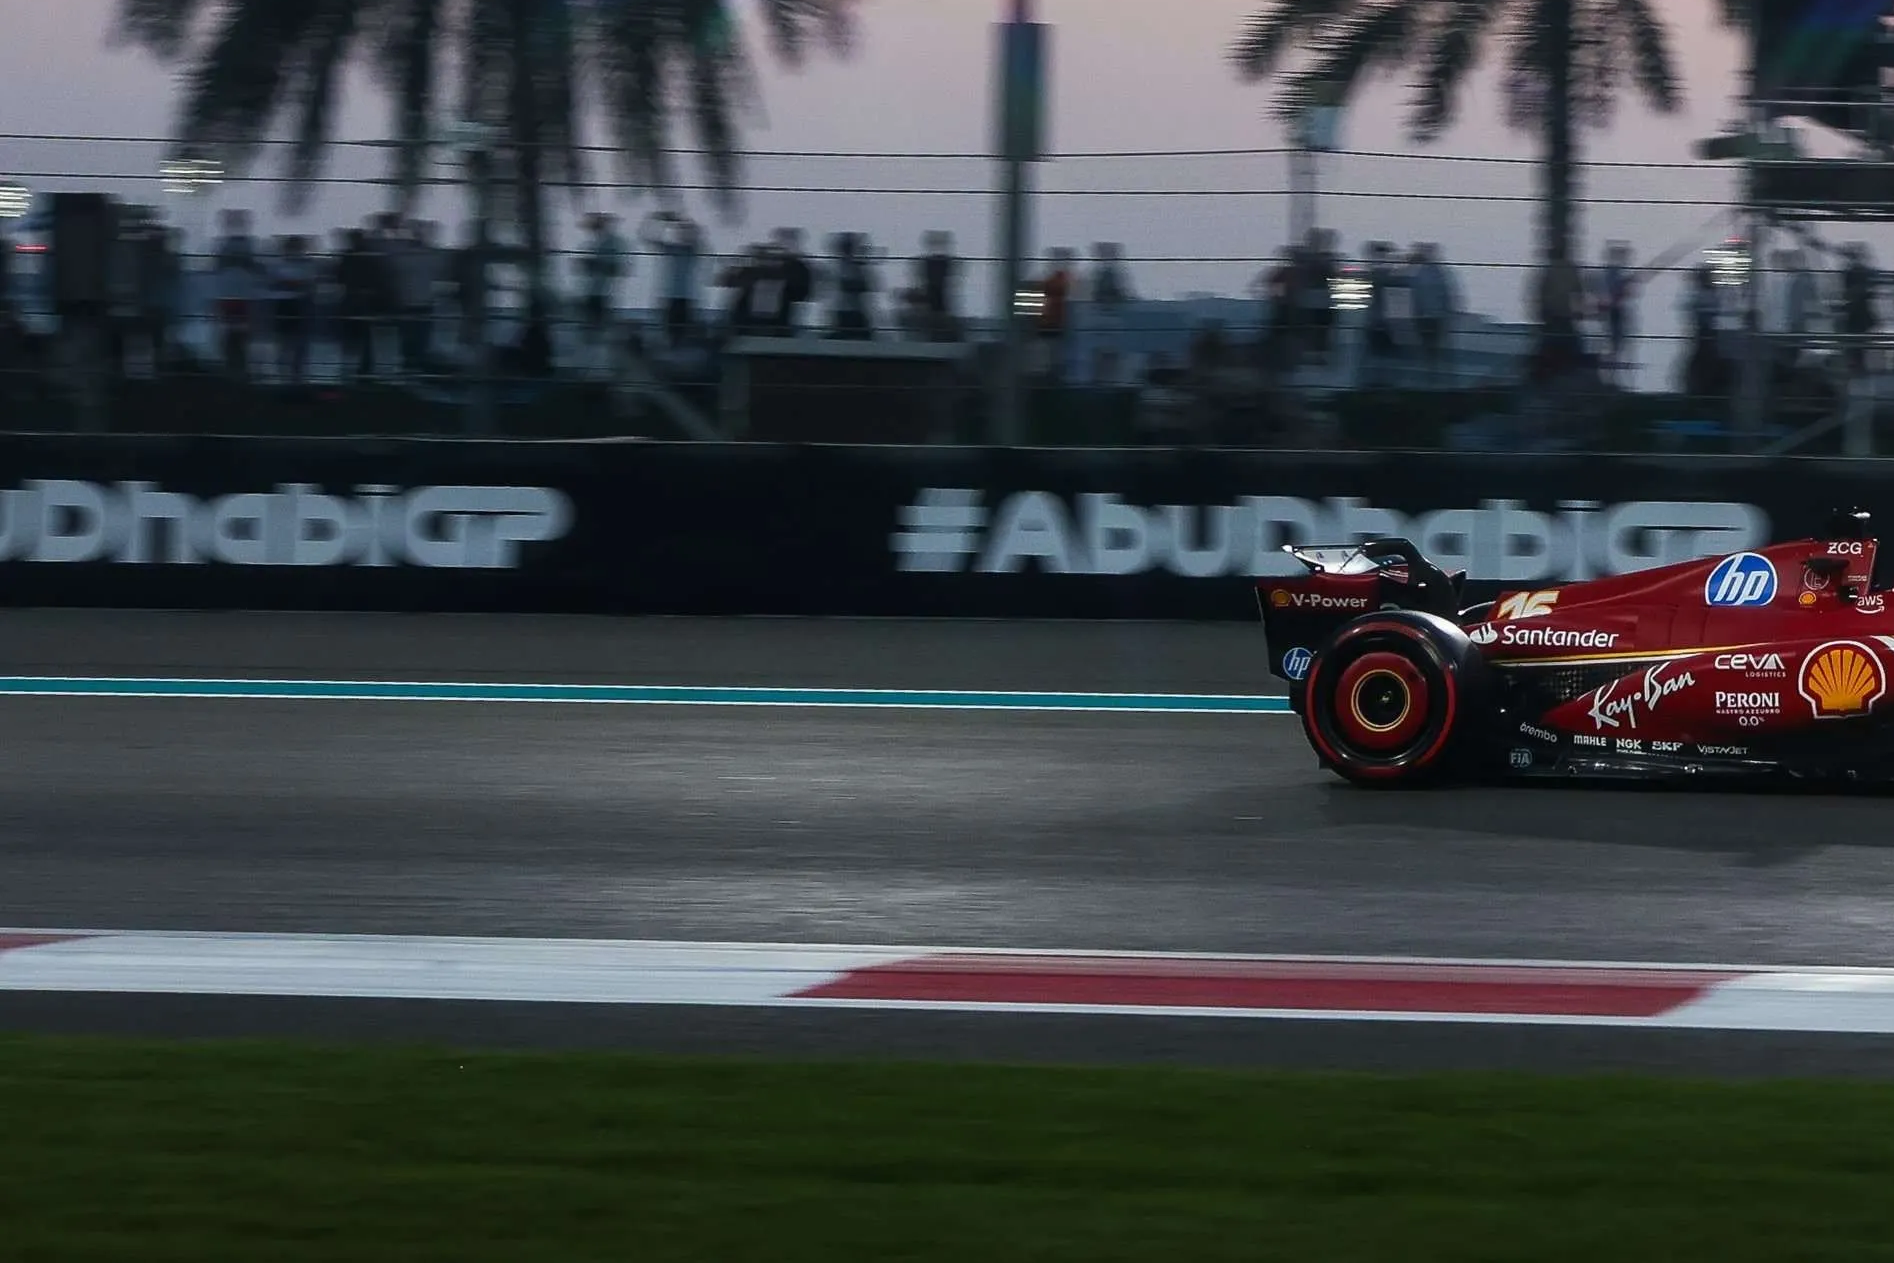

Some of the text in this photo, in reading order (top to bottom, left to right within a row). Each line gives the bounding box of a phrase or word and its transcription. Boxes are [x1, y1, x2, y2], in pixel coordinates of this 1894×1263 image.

[1712, 553, 1770, 606] hp
[1291, 593, 1369, 608] V-Power
[1501, 625, 1620, 648] Santander
[1715, 691, 1781, 708] PERONI
[1573, 734, 1608, 747] MAHLE
[1616, 738, 1643, 750] NGK
[1651, 740, 1684, 752] SKF
